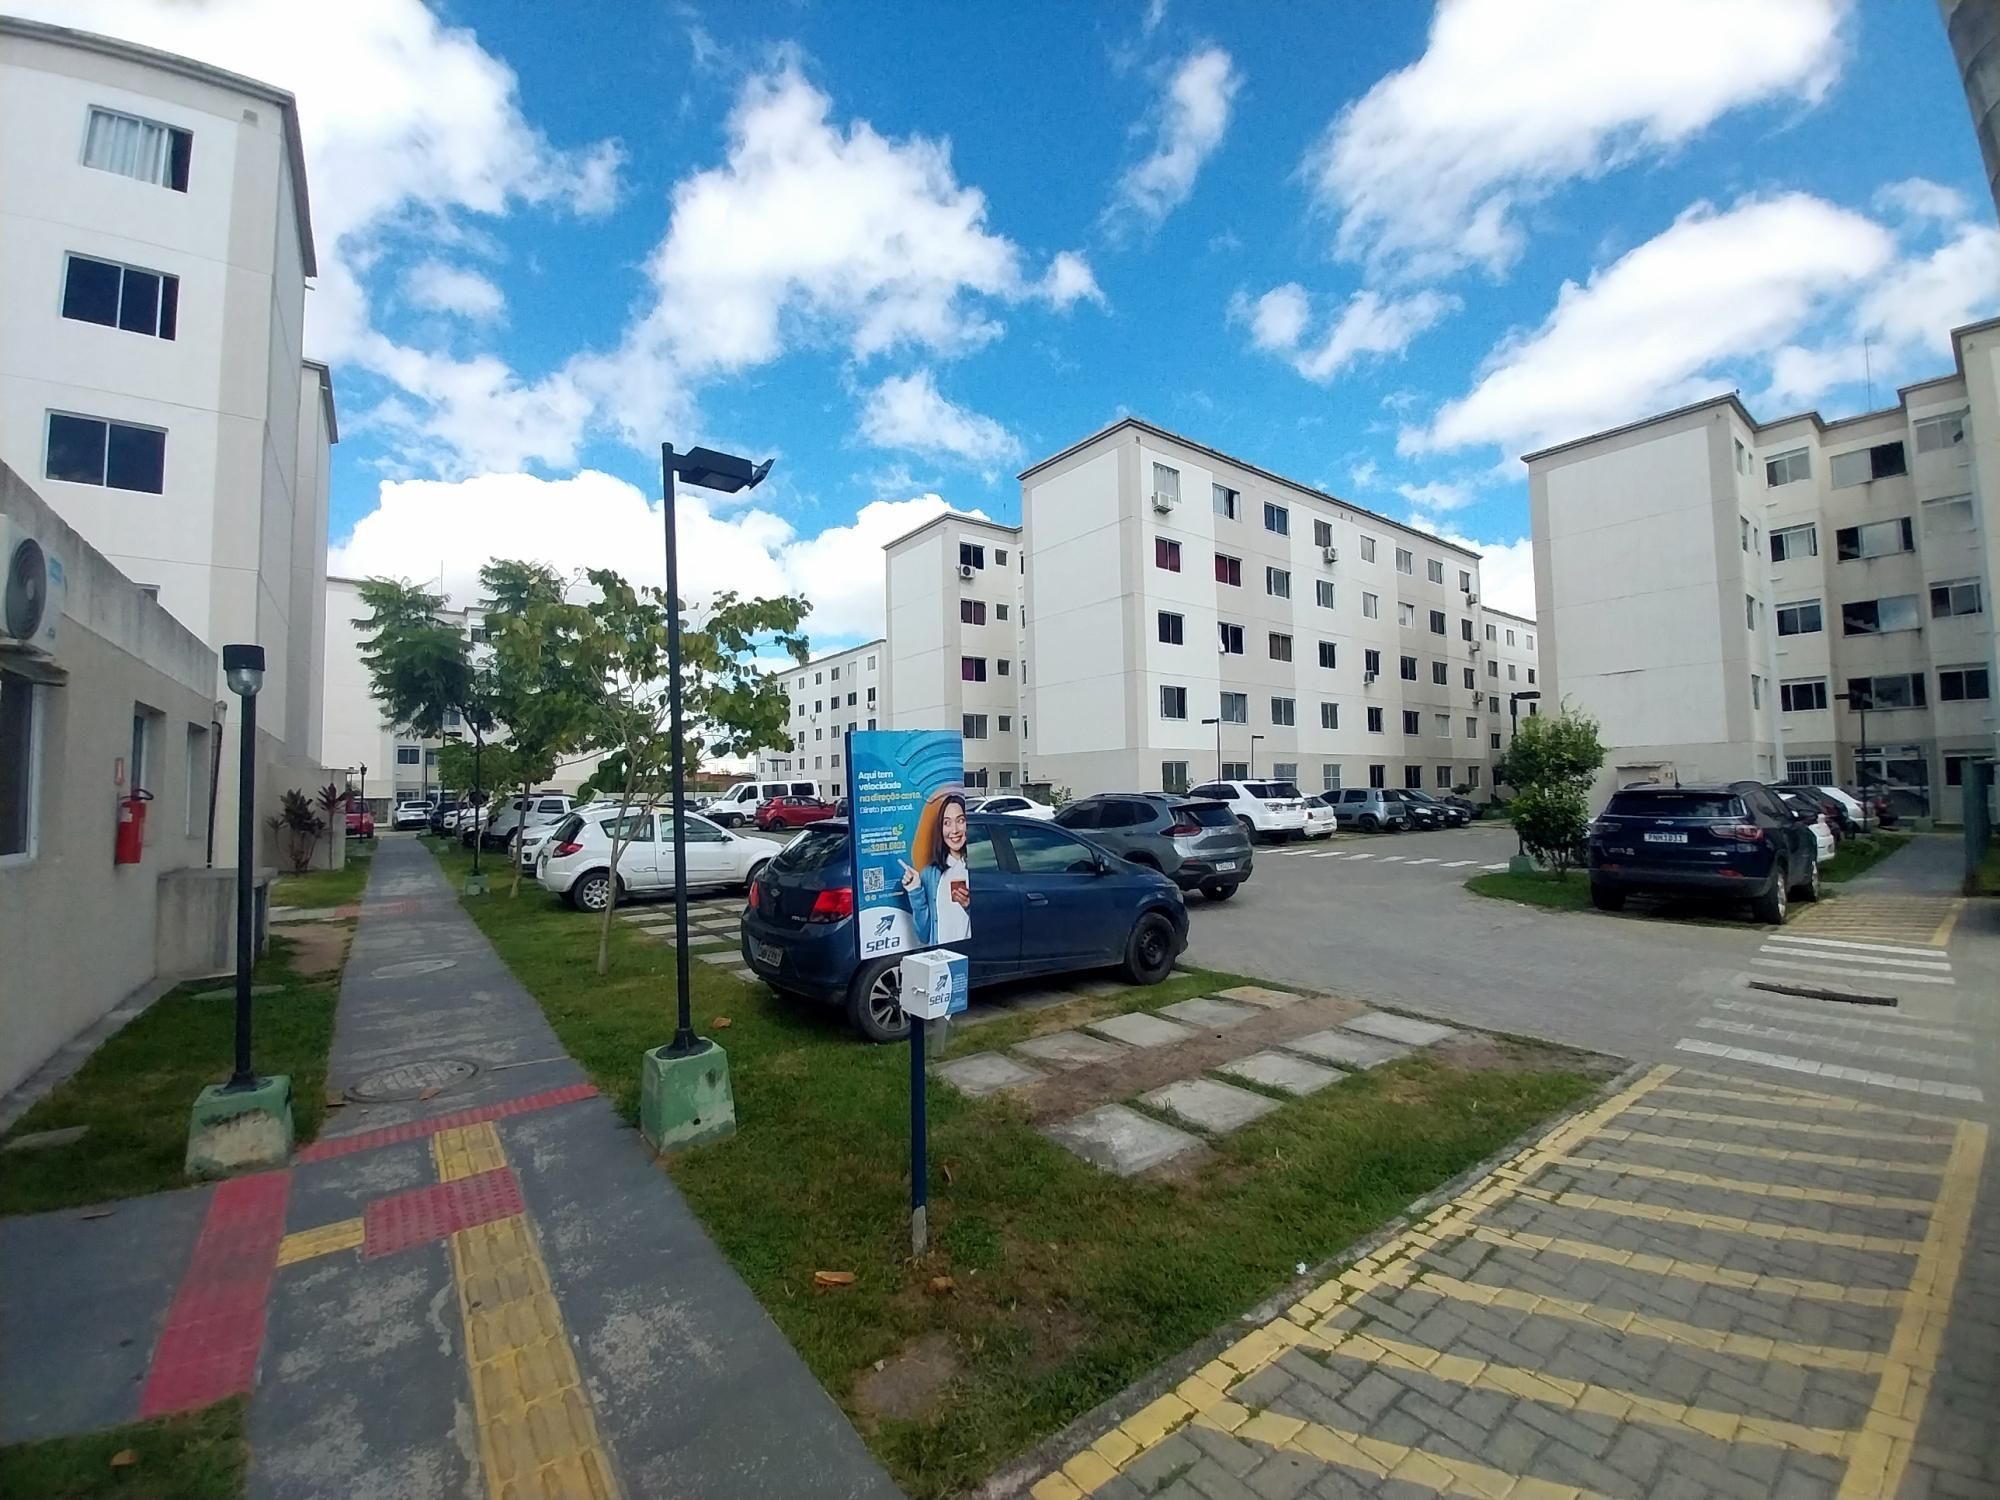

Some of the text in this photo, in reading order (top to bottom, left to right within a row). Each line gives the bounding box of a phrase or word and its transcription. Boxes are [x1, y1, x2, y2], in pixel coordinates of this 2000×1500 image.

[858, 770, 894, 781] Aqui tem
[858, 781, 902, 790] velocidade
[880, 805, 897, 814] para
[866, 936, 900, 953] seta
[929, 993, 951, 1006] seta
